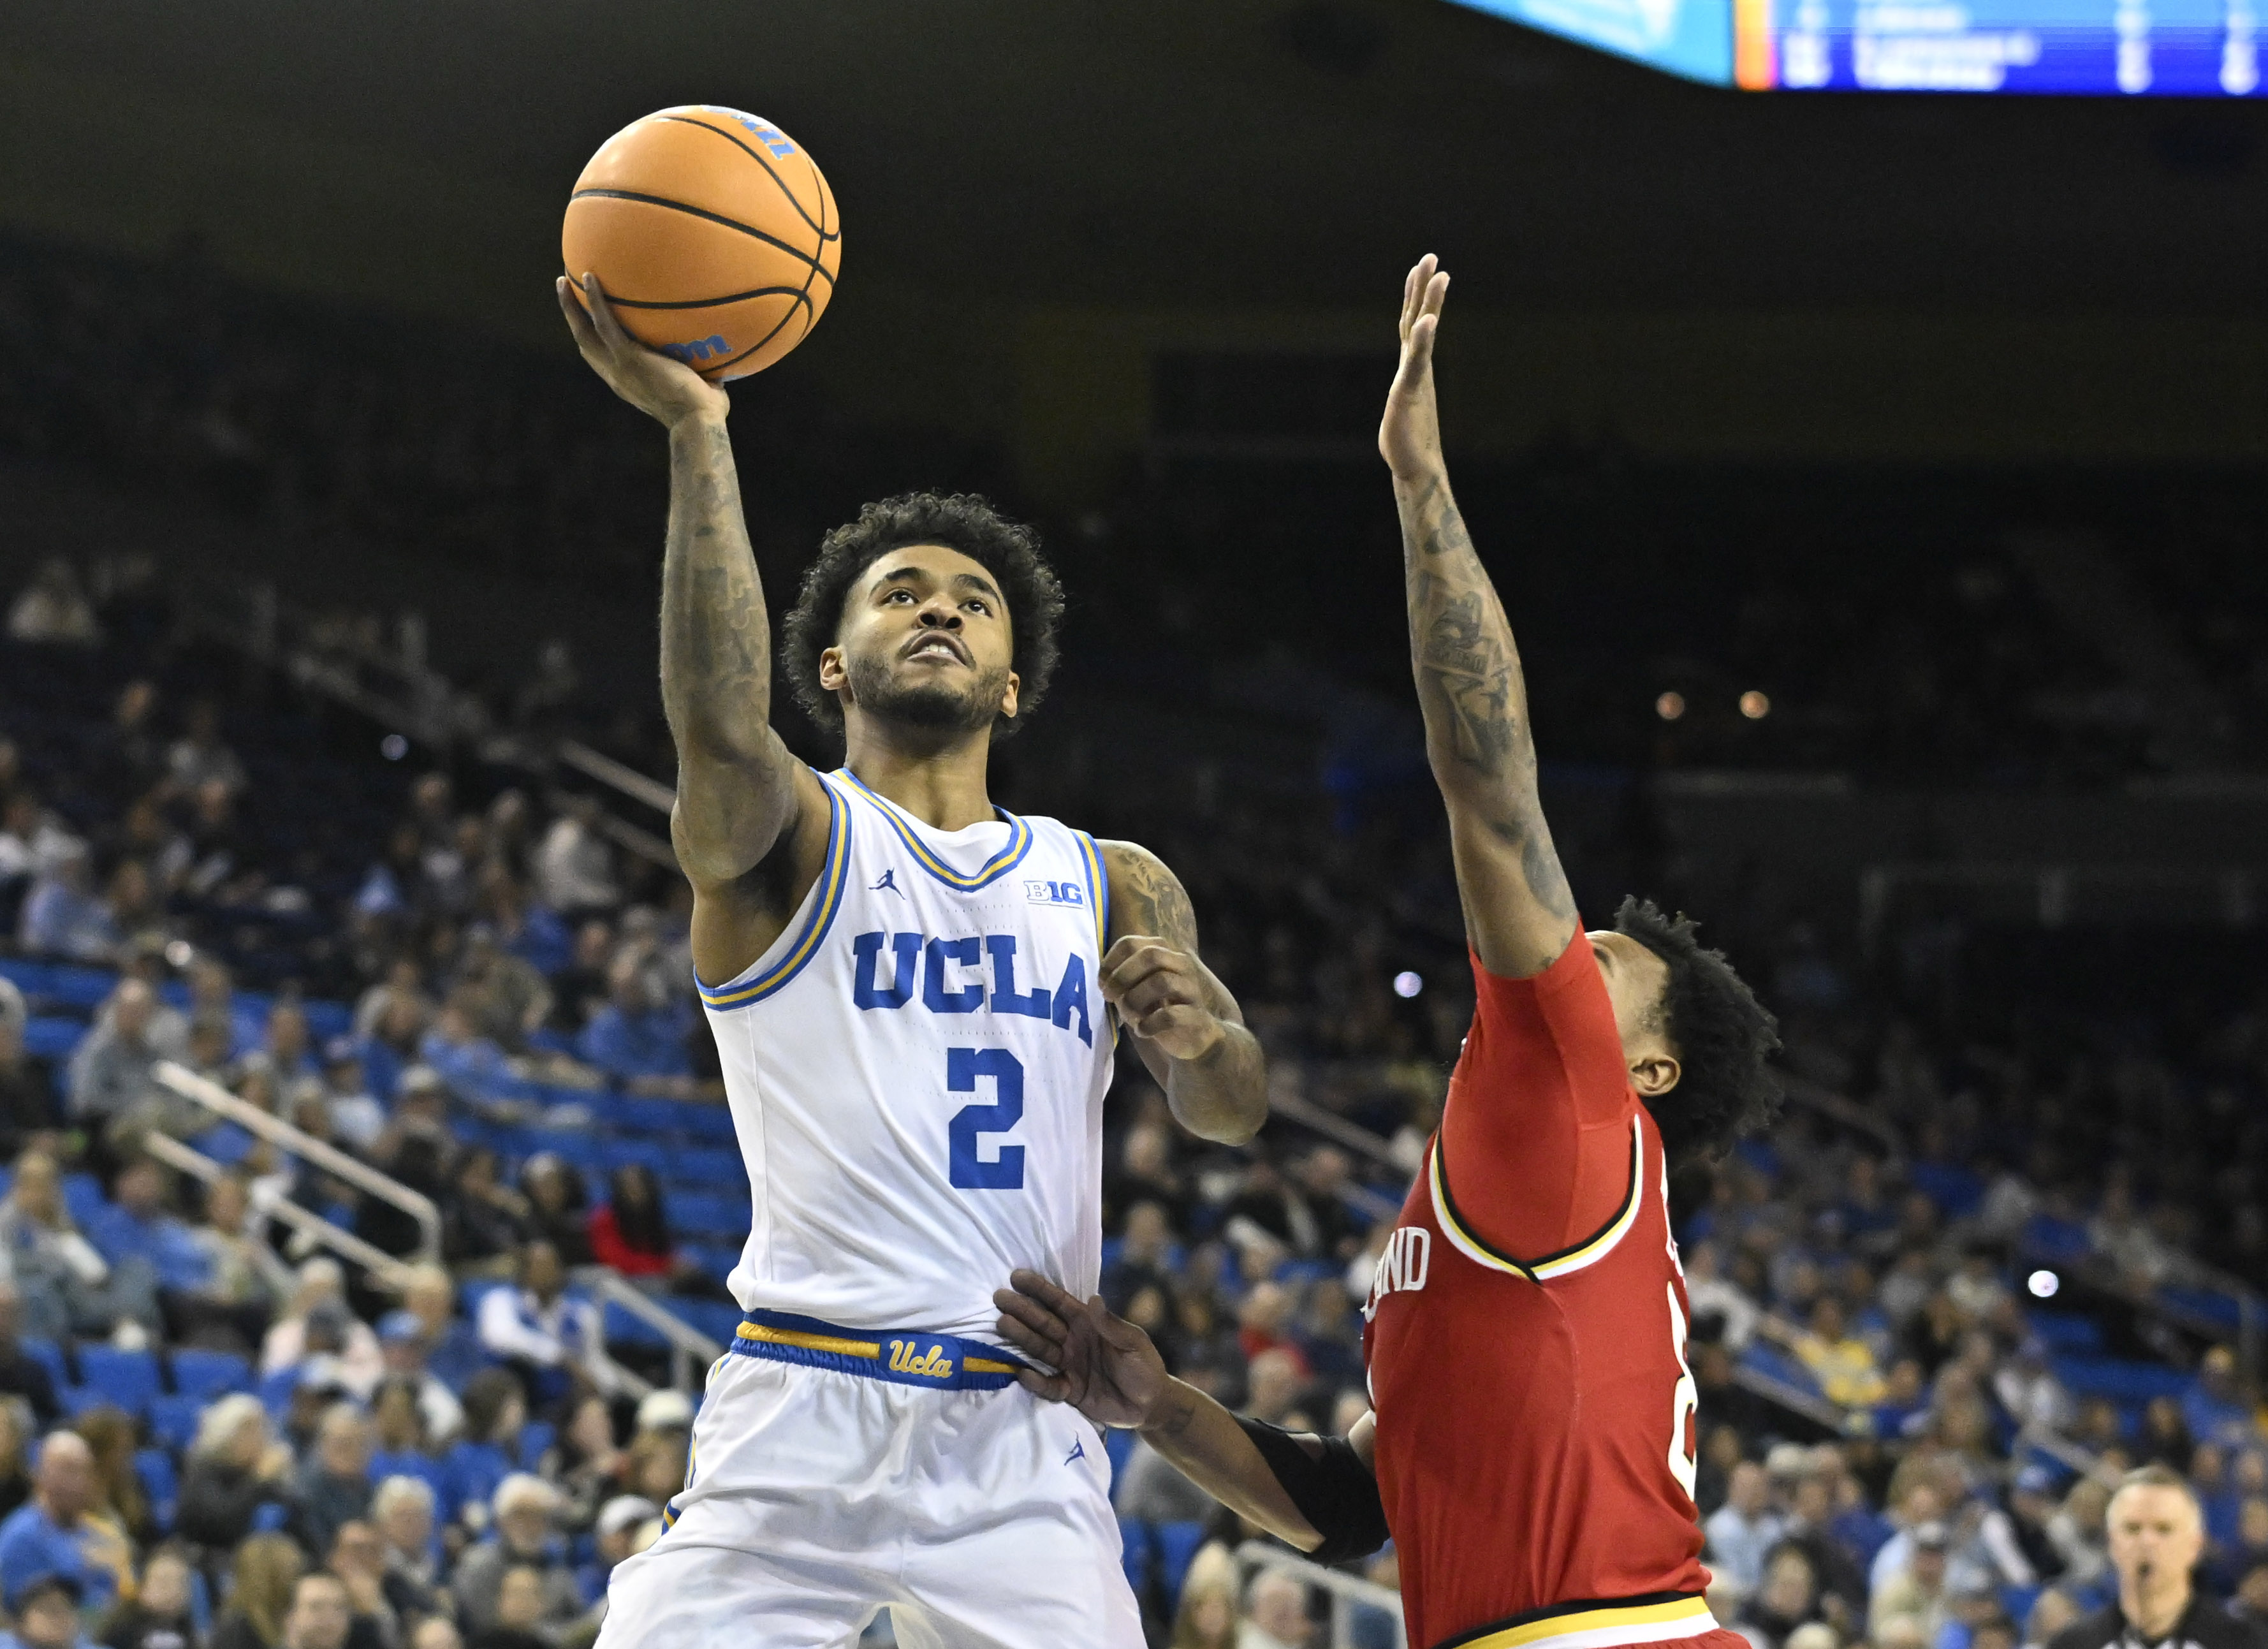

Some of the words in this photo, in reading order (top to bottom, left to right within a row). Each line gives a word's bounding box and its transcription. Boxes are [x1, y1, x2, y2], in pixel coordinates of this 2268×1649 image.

[853, 932, 1092, 1048] UCLA
[947, 1047, 1025, 1189] 2
[889, 1340, 953, 1378] Ucla
